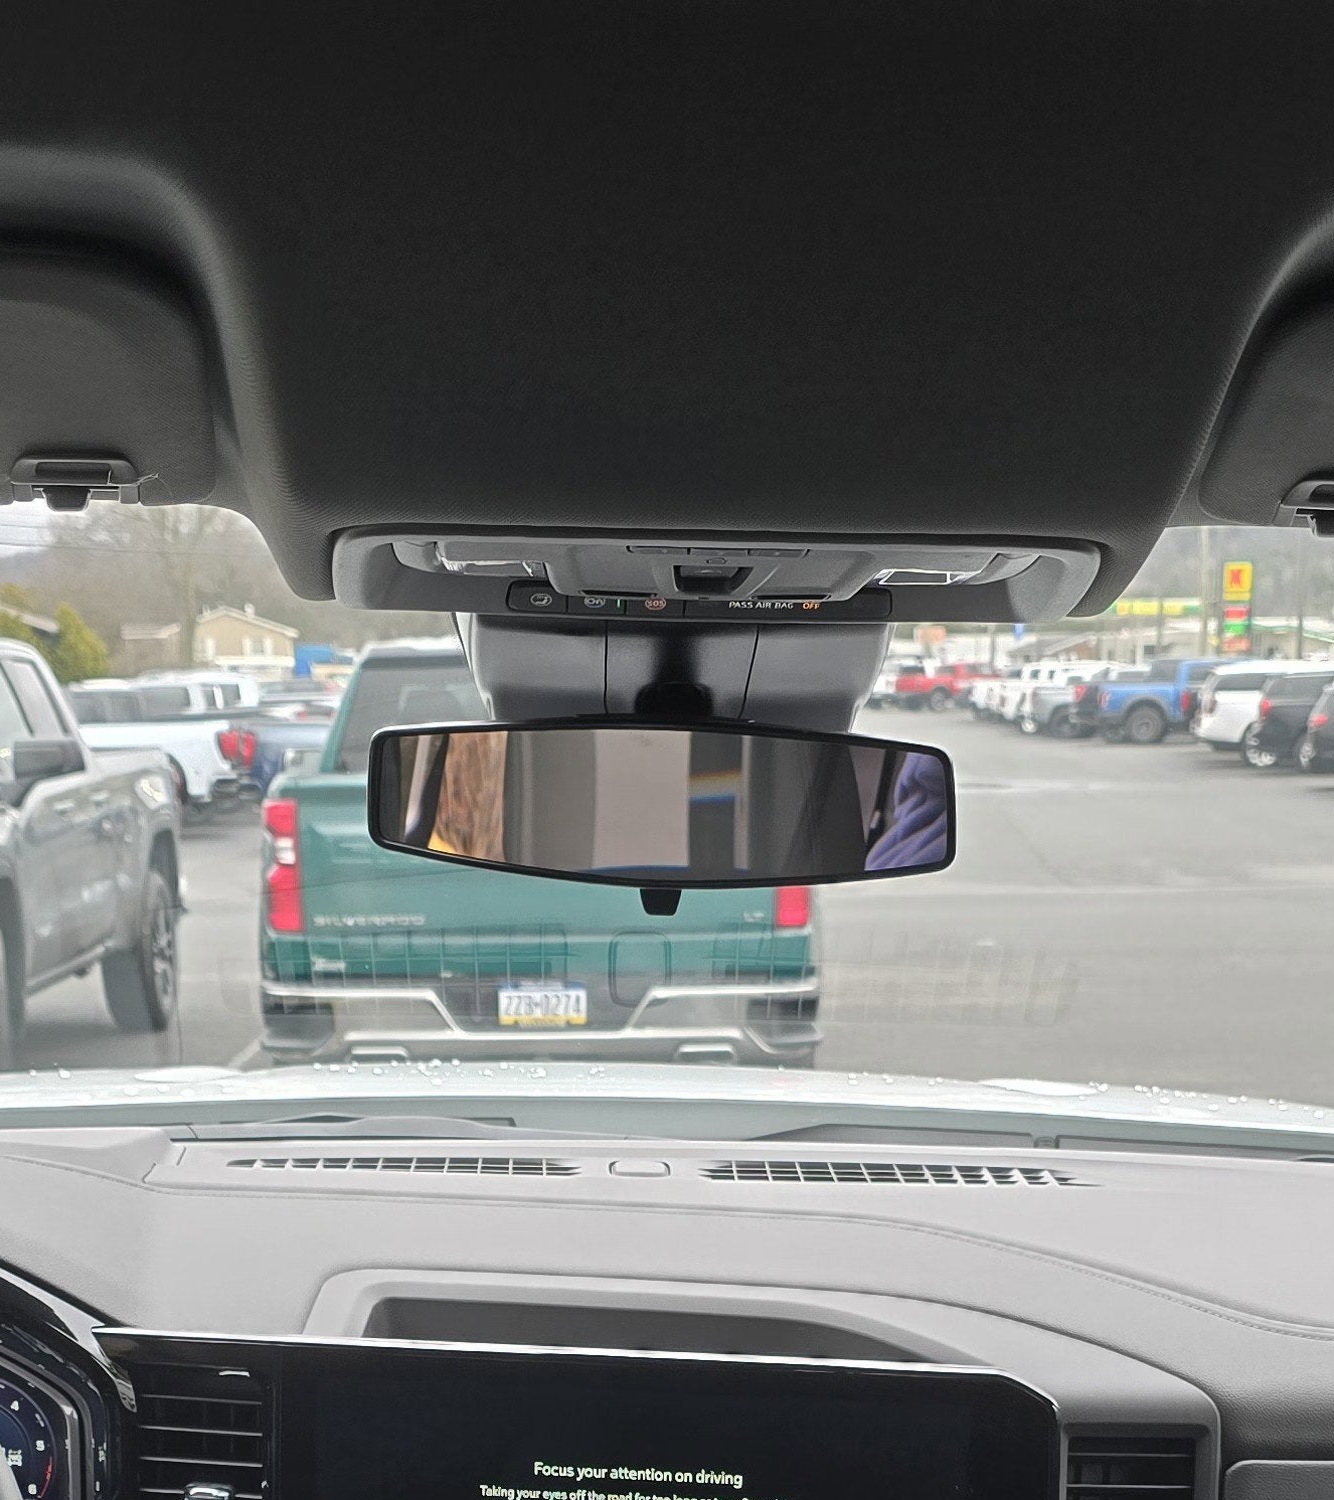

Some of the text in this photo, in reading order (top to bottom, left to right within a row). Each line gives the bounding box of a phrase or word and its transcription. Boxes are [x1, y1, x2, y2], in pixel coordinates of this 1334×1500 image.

[728, 601, 820, 610] PASS AIR BAG OFF
[10, 1400, 20, 1411] 4
[533, 1461, 743, 1489] Focus your attention on driving
[479, 1484, 515, 1499] Taking
[516, 1489, 542, 1500] your
[569, 1489, 587, 1500] off
